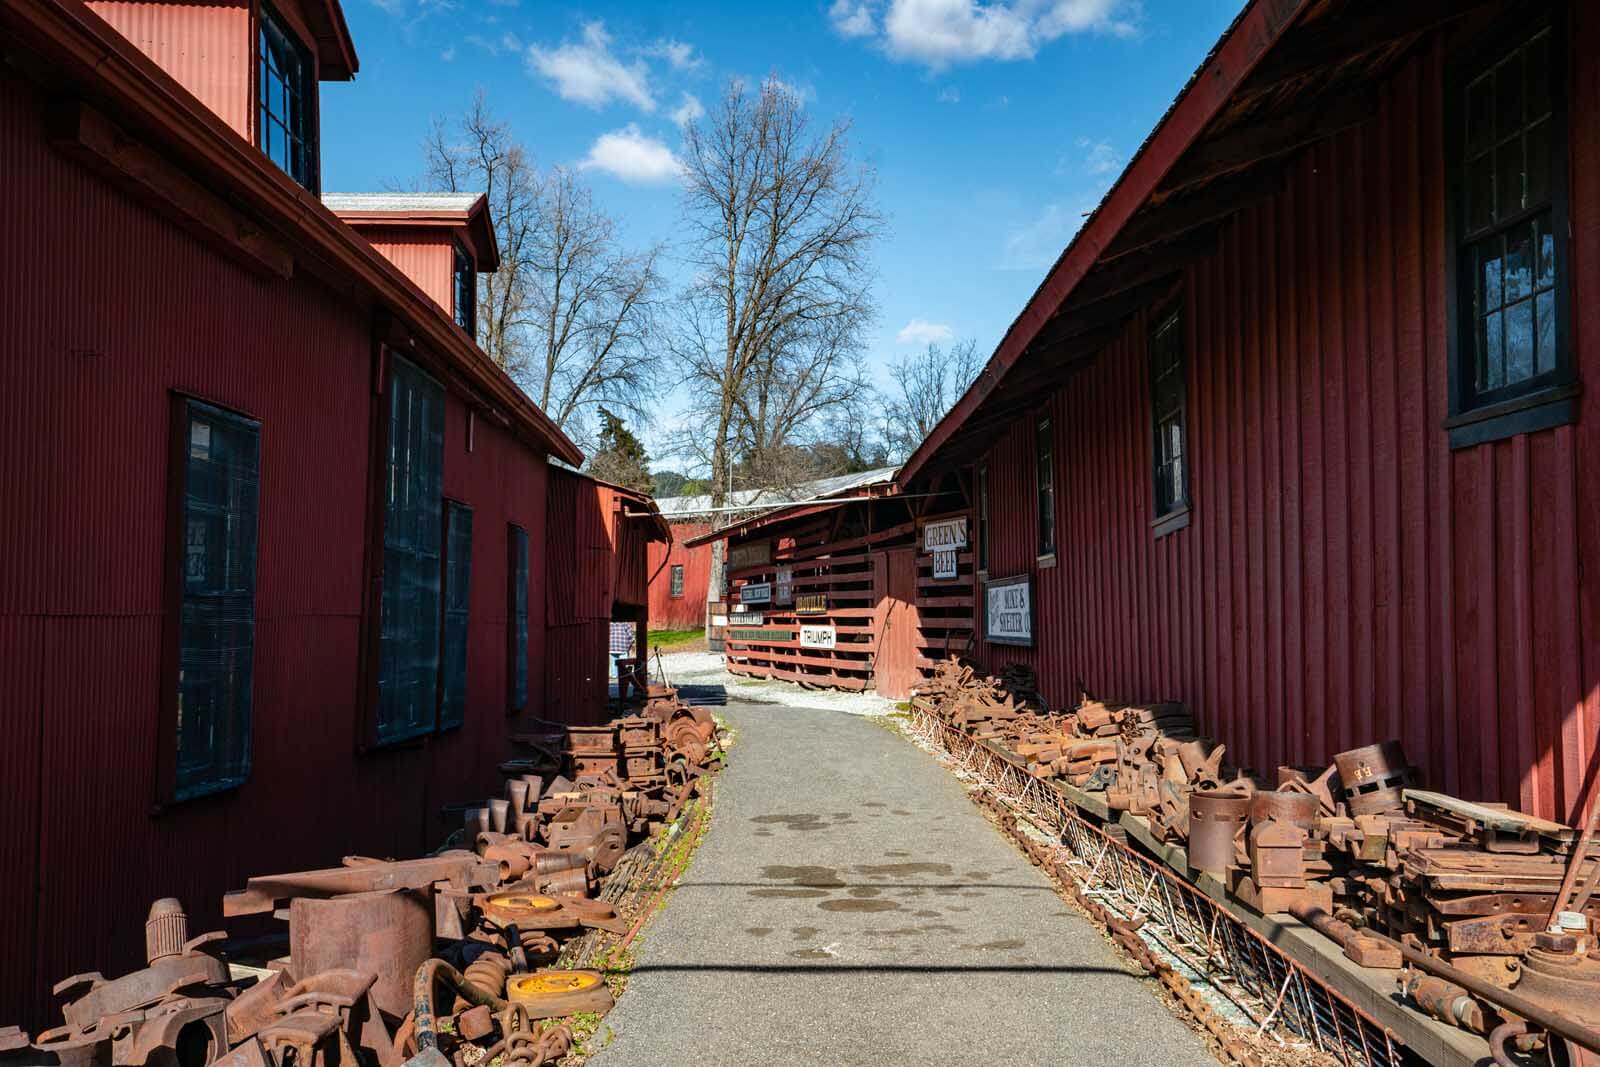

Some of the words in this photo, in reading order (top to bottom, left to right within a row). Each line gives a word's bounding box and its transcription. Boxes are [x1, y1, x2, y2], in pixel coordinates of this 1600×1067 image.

[926, 520, 966, 547] GREEN'S
[935, 552, 955, 573] BEEF
[1000, 613, 1023, 633] SMELTER
[803, 630, 833, 647] TRIUMPH
